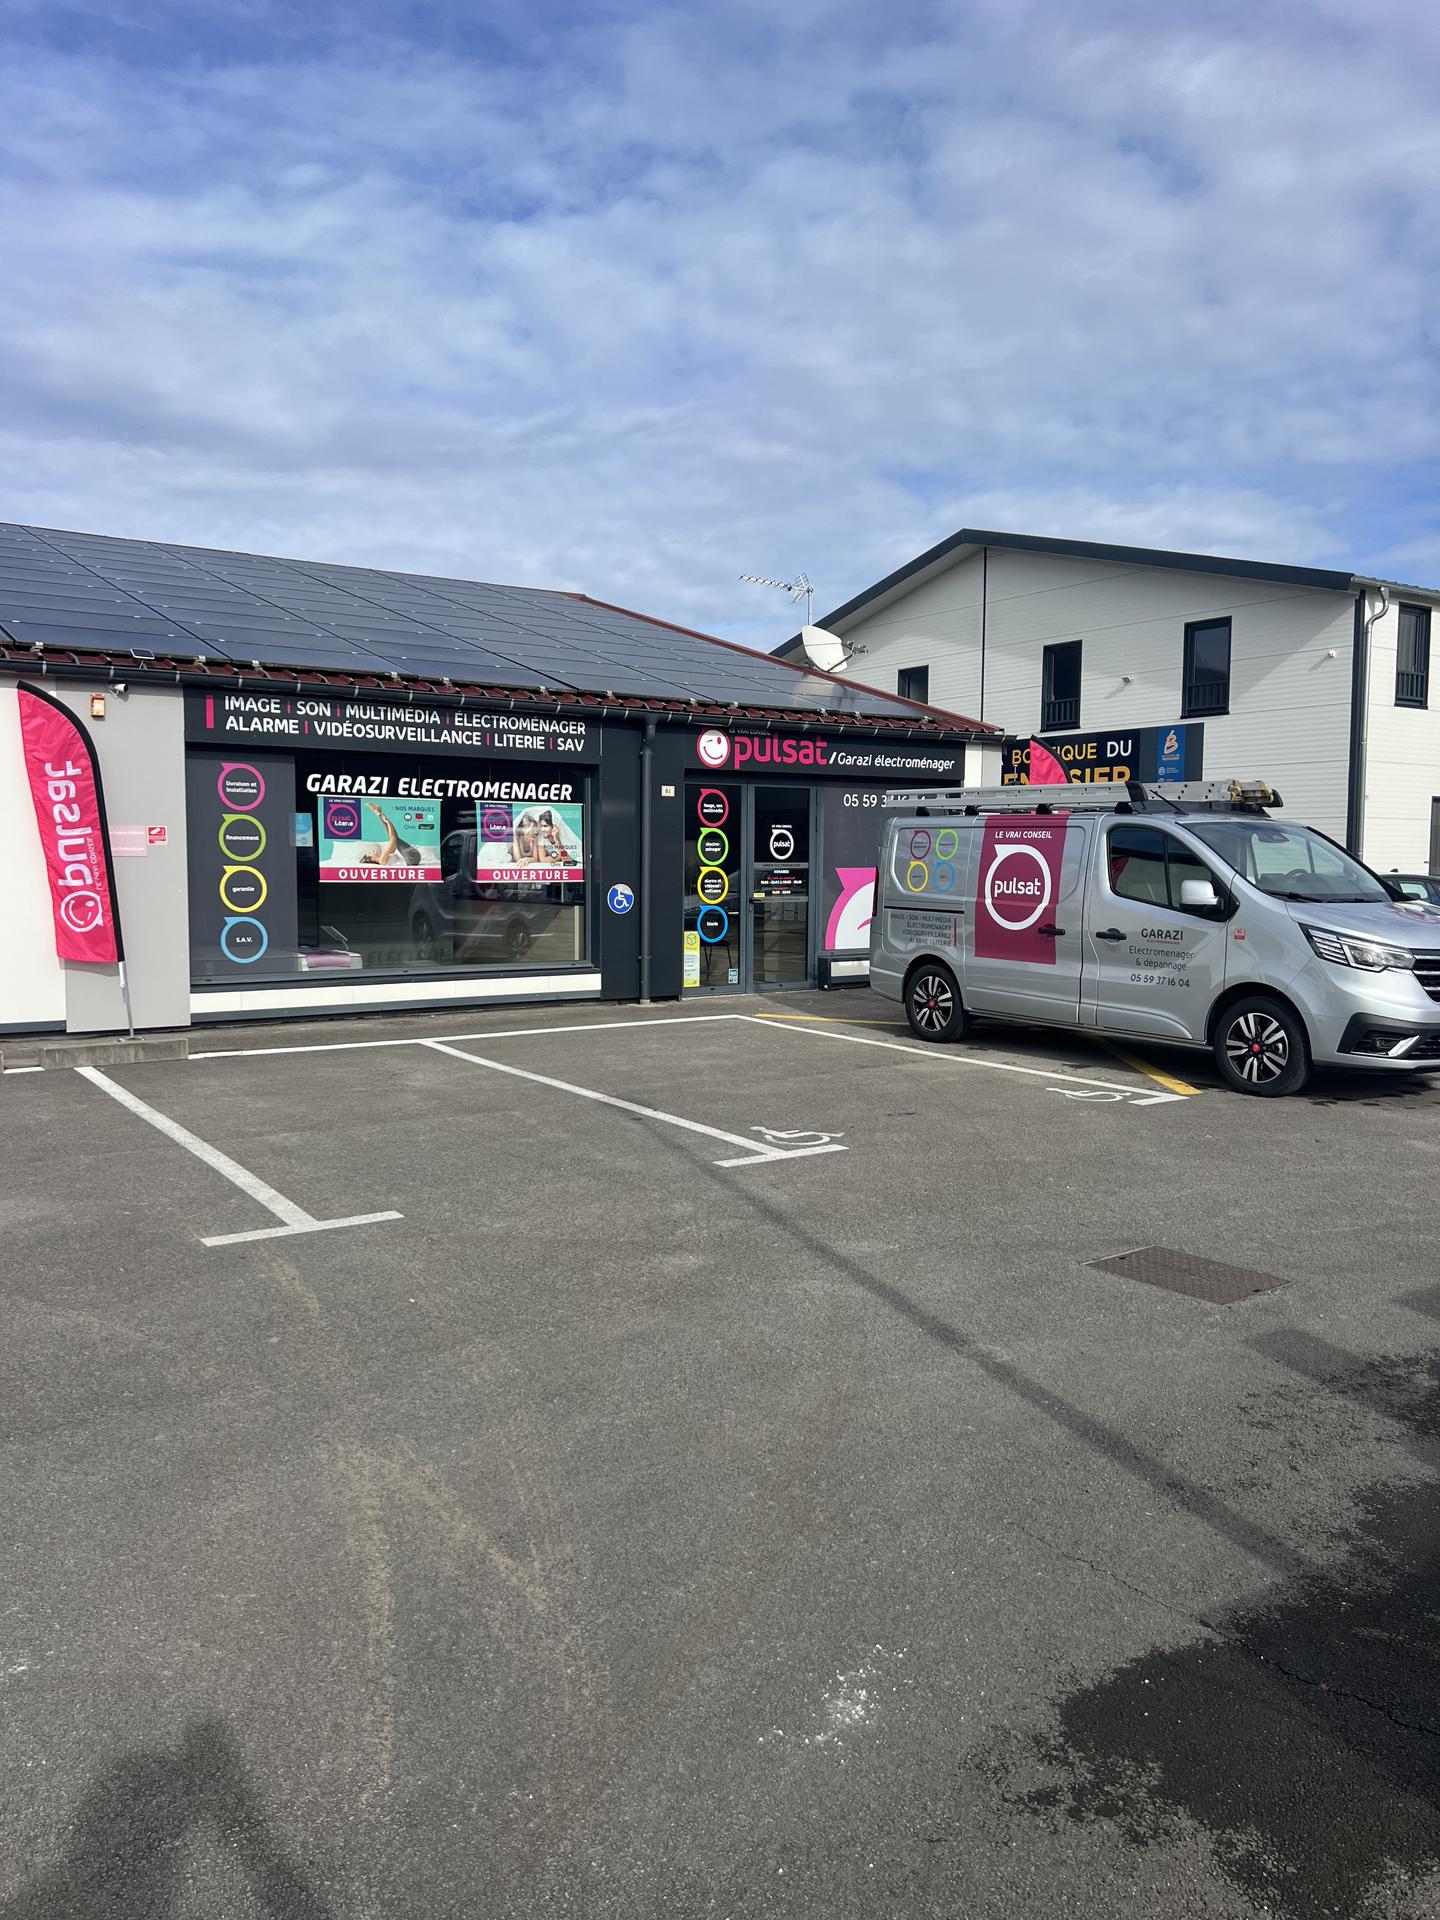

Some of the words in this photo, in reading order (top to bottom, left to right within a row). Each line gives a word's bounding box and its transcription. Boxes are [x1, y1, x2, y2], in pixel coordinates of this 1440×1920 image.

[224, 695, 281, 714] IMAGE
[296, 701, 331, 717] SON
[345, 704, 441, 725] MULTIMÉDIA
[454, 710, 586, 735] ÉLECTROMÉNAGER
[225, 715, 300, 734] ALARME
[313, 721, 482, 745] VIDÉOSURVEILLANCE
[494, 733, 545, 750] LITERIE
[556, 737, 585, 752] SAV
[734, 734, 828, 769] pulsat
[874, 754, 955, 772] électroménager
[1106, 740, 1132, 757] DU
[306, 773, 389, 795] GARAZI
[397, 777, 573, 801] ELECTROMENAGER
[843, 793, 859, 807] 05
[862, 794, 878, 807] 59
[995, 831, 1004, 839] LE
[1005, 831, 1021, 839] VRAI
[1022, 831, 1053, 839] CONSEIL
[773, 840, 791, 849] pulsat
[338, 869, 426, 880] OUVERTURE
[492, 870, 569, 880] OUVERTURE
[994, 877, 1042, 898] pulsat
[1141, 928, 1184, 941] GARAZI
[1135, 958, 1142, 966] &
[1130, 973, 1141, 983] 05
[1143, 974, 1155, 984] 59
[1156, 976, 1166, 985] 37
[1167, 977, 1176, 986] 16
[1178, 978, 1190, 988] 04
